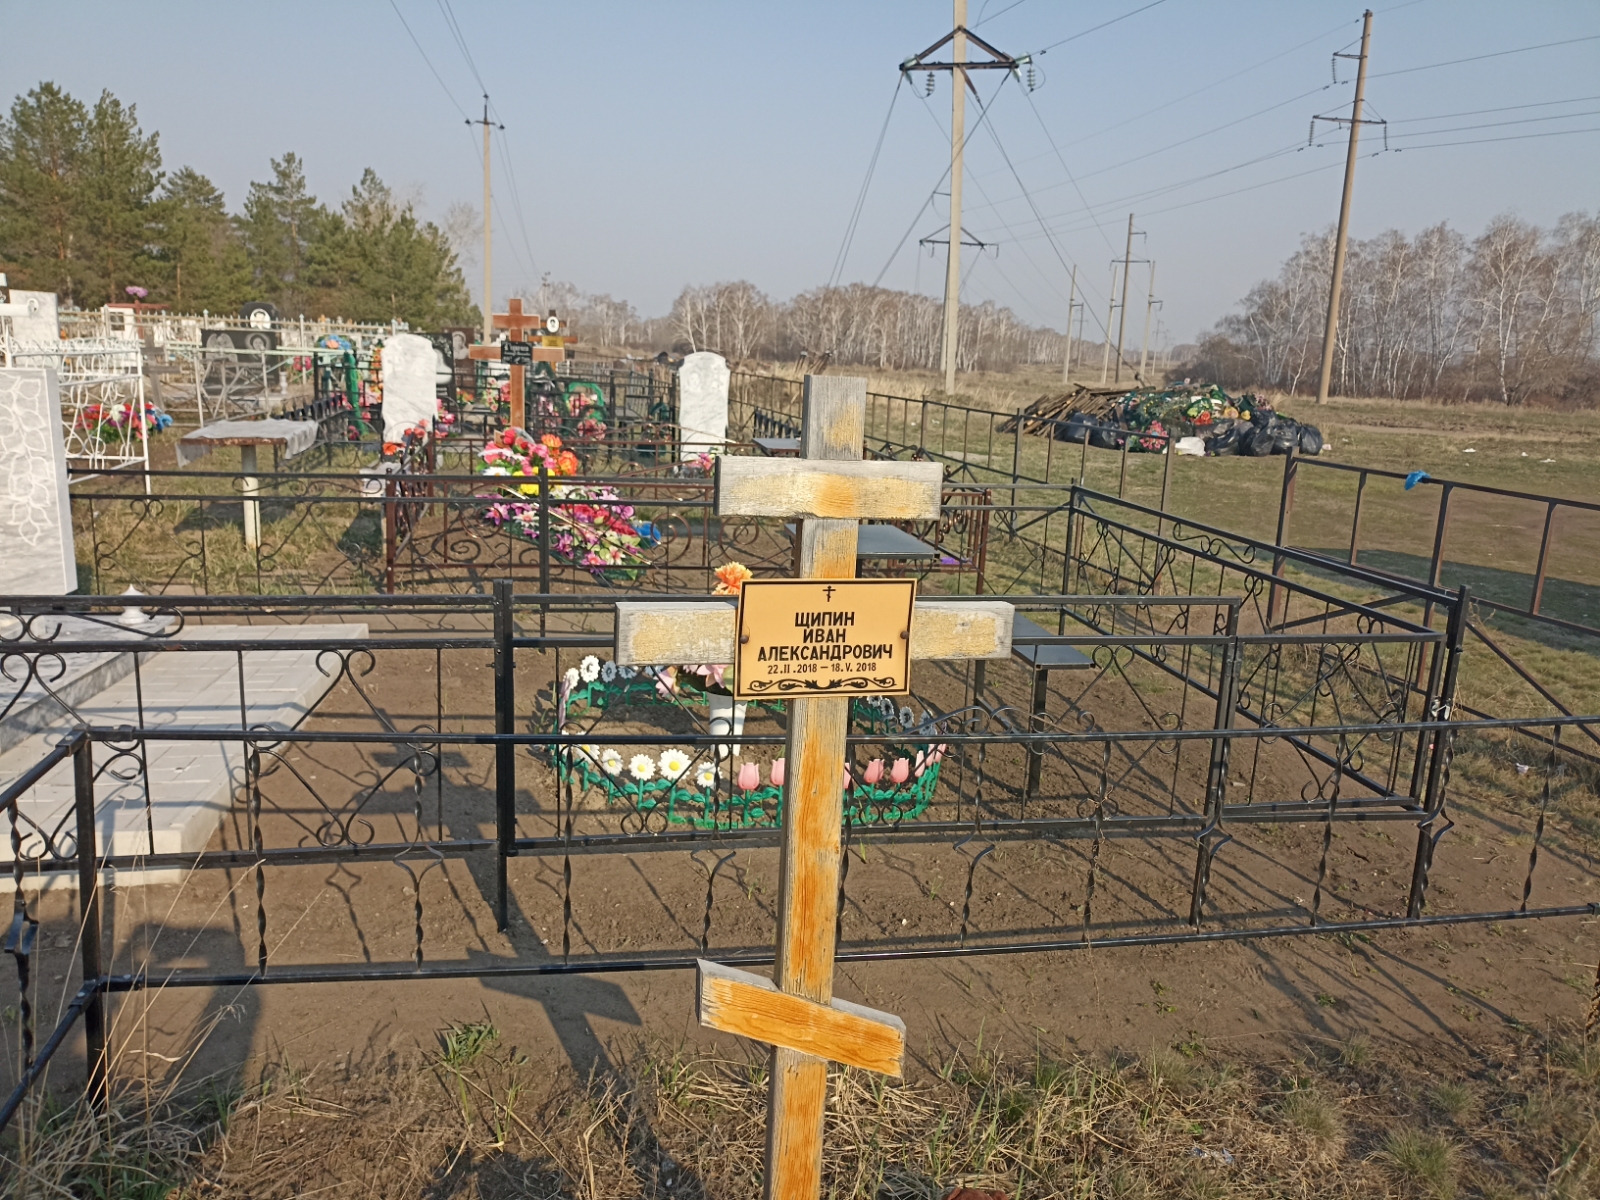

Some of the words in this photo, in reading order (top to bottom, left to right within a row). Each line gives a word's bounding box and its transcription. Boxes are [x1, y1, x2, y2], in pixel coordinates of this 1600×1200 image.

[795, 611, 855, 628] ЩИПИН
[803, 628, 846, 643] ИВАН
[758, 644, 893, 661] АЛЕКСАНДРОВИЧ
